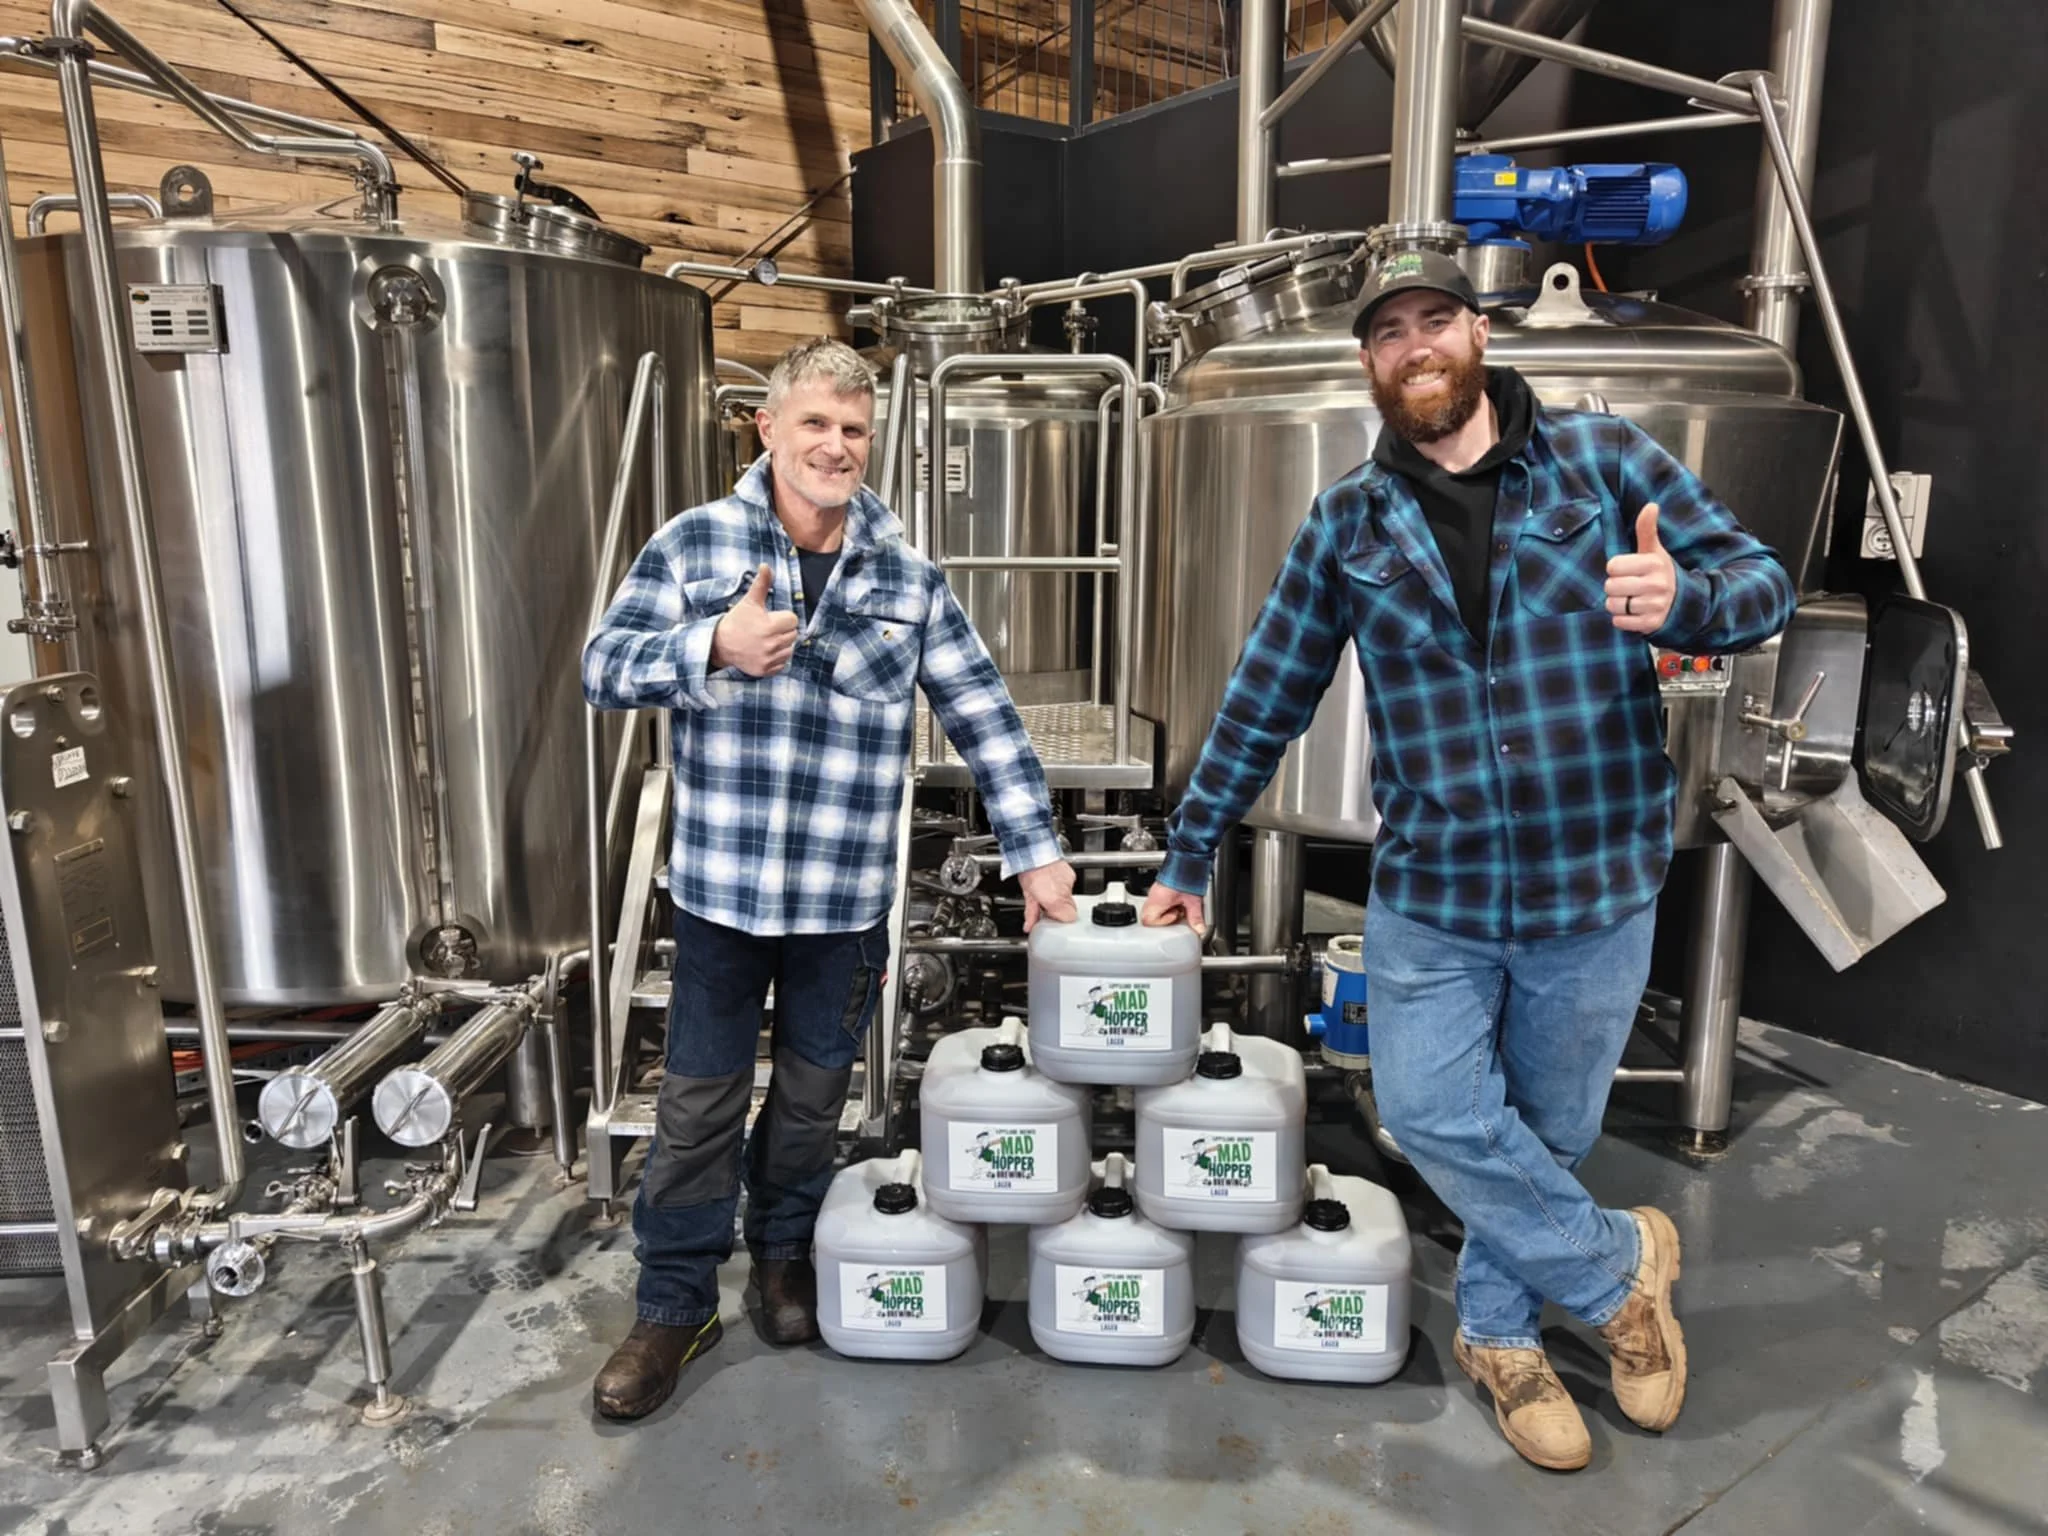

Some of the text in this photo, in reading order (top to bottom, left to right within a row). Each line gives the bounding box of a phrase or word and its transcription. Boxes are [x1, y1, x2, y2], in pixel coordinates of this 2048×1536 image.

[1113, 990, 1147, 1010] MAD
[1104, 1011, 1148, 1032] HOPPER
[1001, 1135, 1034, 1155] MAD
[1218, 1143, 1251, 1163] MAD
[992, 1156, 1034, 1175] HOPPER
[1208, 1163, 1252, 1182] HOPPER
[890, 1277, 922, 1295] MAD
[1107, 1280, 1140, 1299] MAD
[882, 1296, 924, 1314] HOPPER
[1098, 1300, 1141, 1318] HOPPER
[1330, 1296, 1363, 1315] MAD
[1320, 1316, 1363, 1335] HOPPER
